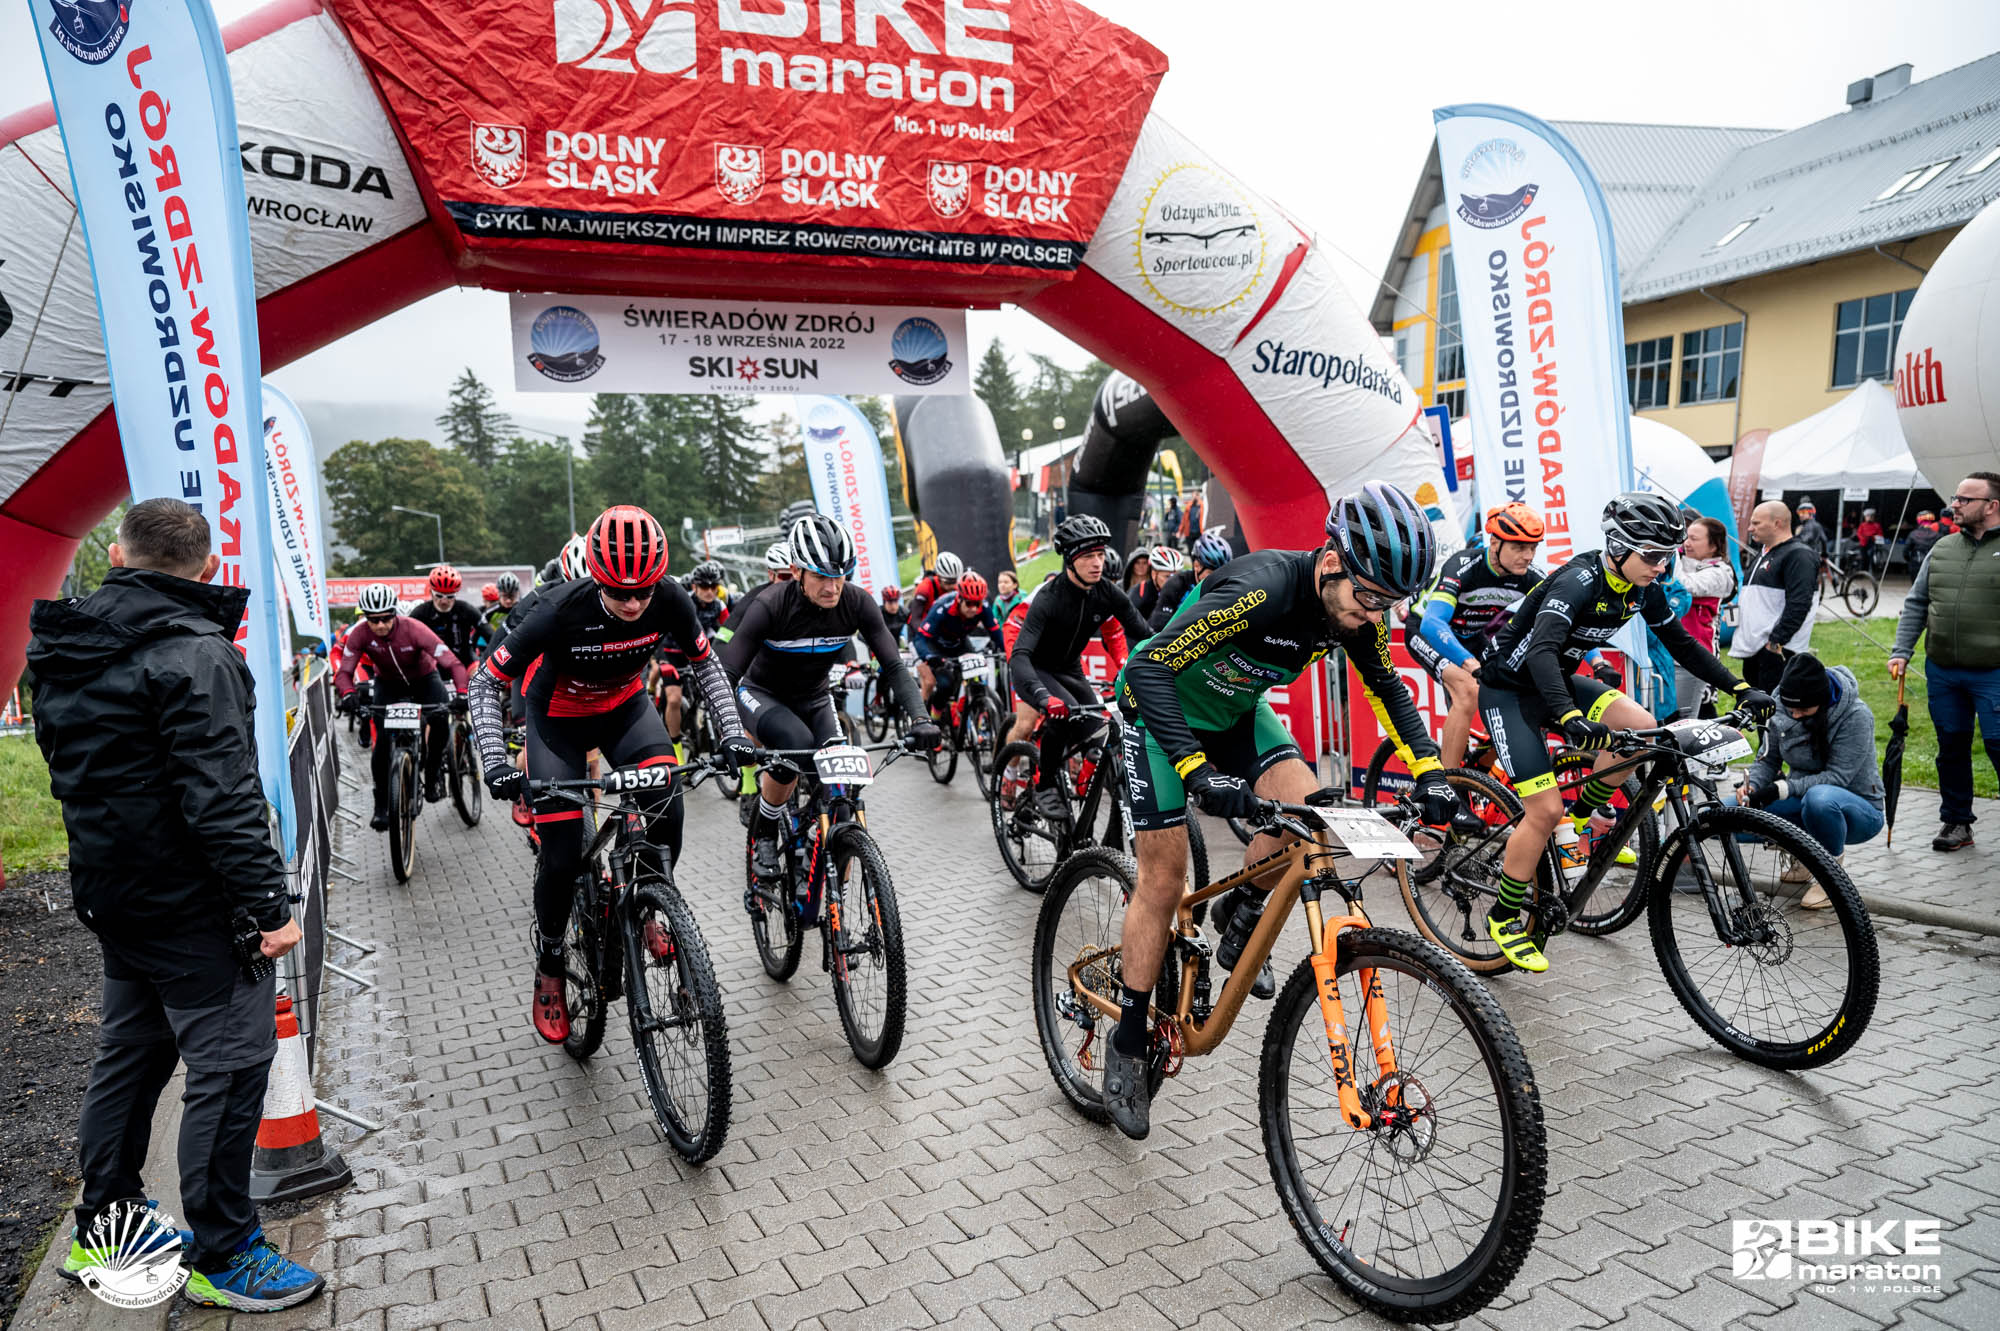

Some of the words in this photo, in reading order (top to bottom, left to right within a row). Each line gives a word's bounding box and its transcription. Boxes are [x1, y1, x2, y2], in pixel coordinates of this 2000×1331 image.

[720, 46, 1015, 113] maraton
[893, 115, 924, 136] No.
[928, 119, 938, 136] 1
[940, 122, 956, 138] w
[958, 121, 1015, 144] Polsce!
[545, 129, 666, 166] DOLNY
[546, 154, 660, 197] ŚLĄSK
[781, 148, 886, 181] DOLNY
[781, 172, 881, 211] ŚLĄSK
[984, 165, 1078, 197] DOLNY
[247, 196, 373, 234] WROCŁAW
[984, 187, 1072, 225] ŚLĄSK
[475, 212, 535, 231] CYKL
[542, 212, 711, 242] NAJWIĘKSZYCH
[716, 226, 790, 246] IMPREZ
[795, 230, 935, 255] ROWEROWYCH
[938, 239, 976, 257] MTB
[980, 242, 997, 257] W
[1000, 243, 1072, 264] POLSCE!
[1153, 249, 1253, 277] Sportowcow.pl
[623, 303, 788, 333] ŚWIERADÓW
[795, 310, 875, 334] ZDRÓJ
[658, 333, 677, 346] 17
[694, 334, 712, 347] 18
[717, 333, 806, 349] WRZEŚNIA
[810, 337, 845, 350] 2022
[689, 356, 733, 378] SKI
[764, 357, 819, 379] SUN
[1251, 338, 1403, 405] Staropolanka
[1148, 619, 1210, 662] Oborniki
[1207, 588, 1267, 627] Śląskie
[1205, 619, 1249, 647] Team
[571, 645, 602, 653] PRO
[604, 633, 658, 652] ROWERY
[387, 709, 419, 719] 2423
[609, 766, 666, 791] 1552
[820, 757, 868, 774] 1250
[1737, 1032, 1759, 1047] SWISS
[1806, 1015, 1847, 1056] MAXXIS
[1329, 1042, 1354, 1091] FOX
